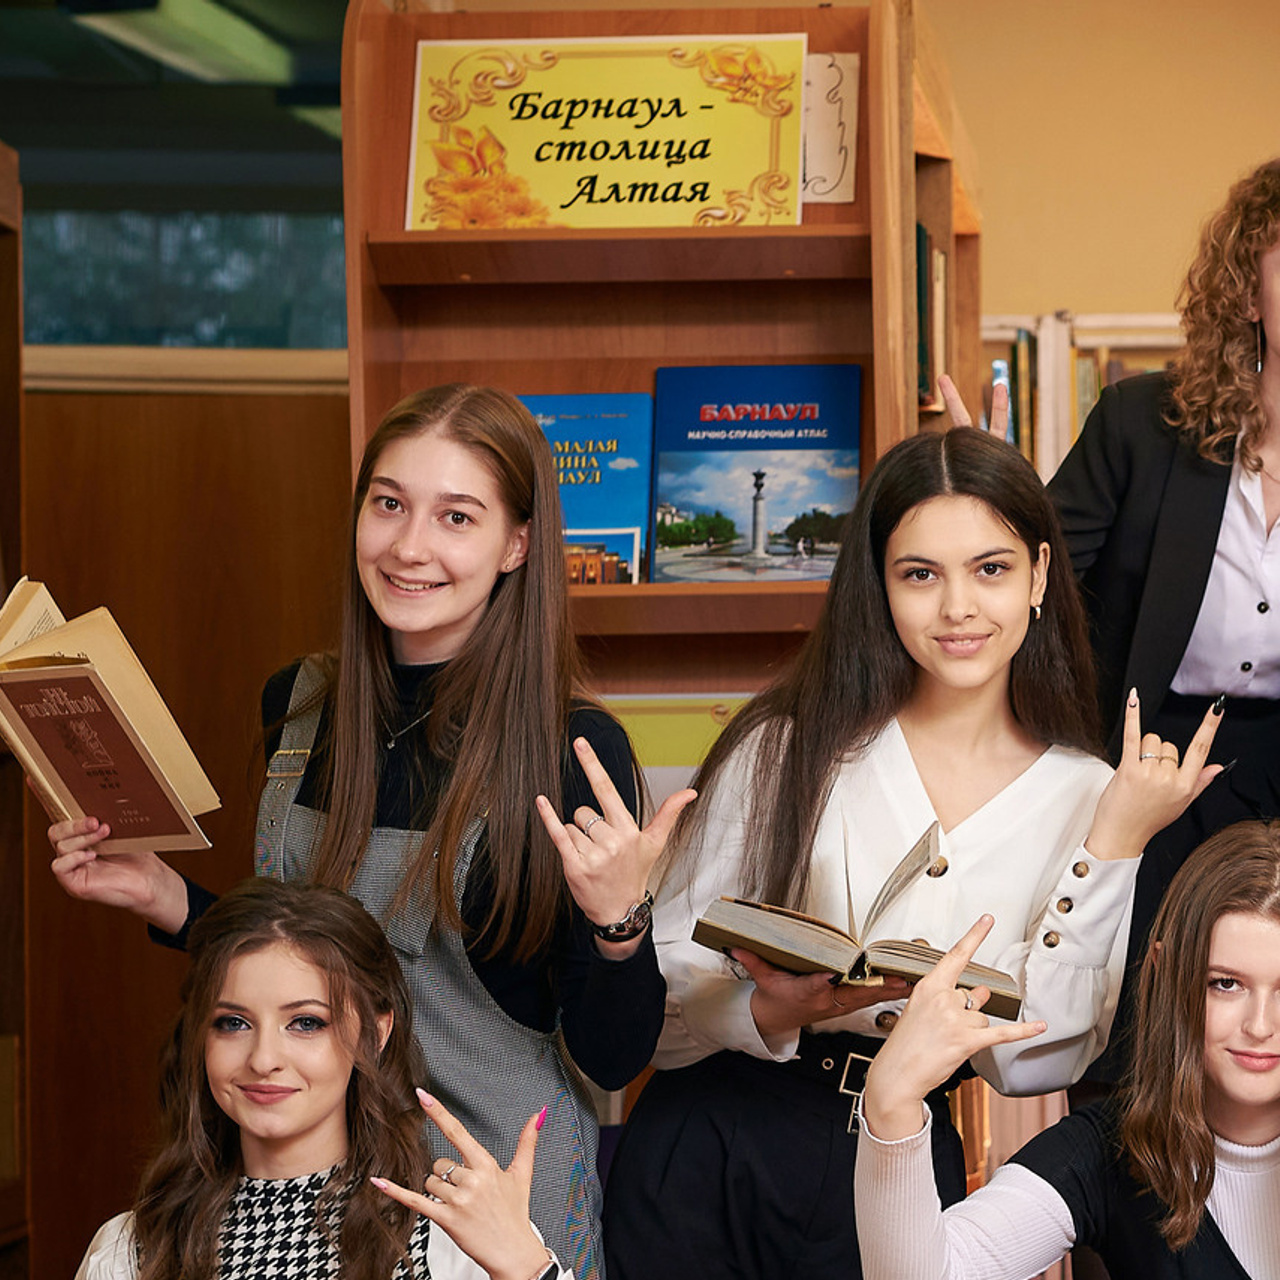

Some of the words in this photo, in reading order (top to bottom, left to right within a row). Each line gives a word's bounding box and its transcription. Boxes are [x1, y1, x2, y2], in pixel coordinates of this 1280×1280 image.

[509, 92, 687, 130] Барнаул
[535, 138, 711, 168] столица
[560, 174, 710, 209] Алтая
[700, 403, 819, 421] БАРНАУЛ
[797, 428, 828, 439] АТЛАС
[553, 439, 618, 453] МАЛАЯ
